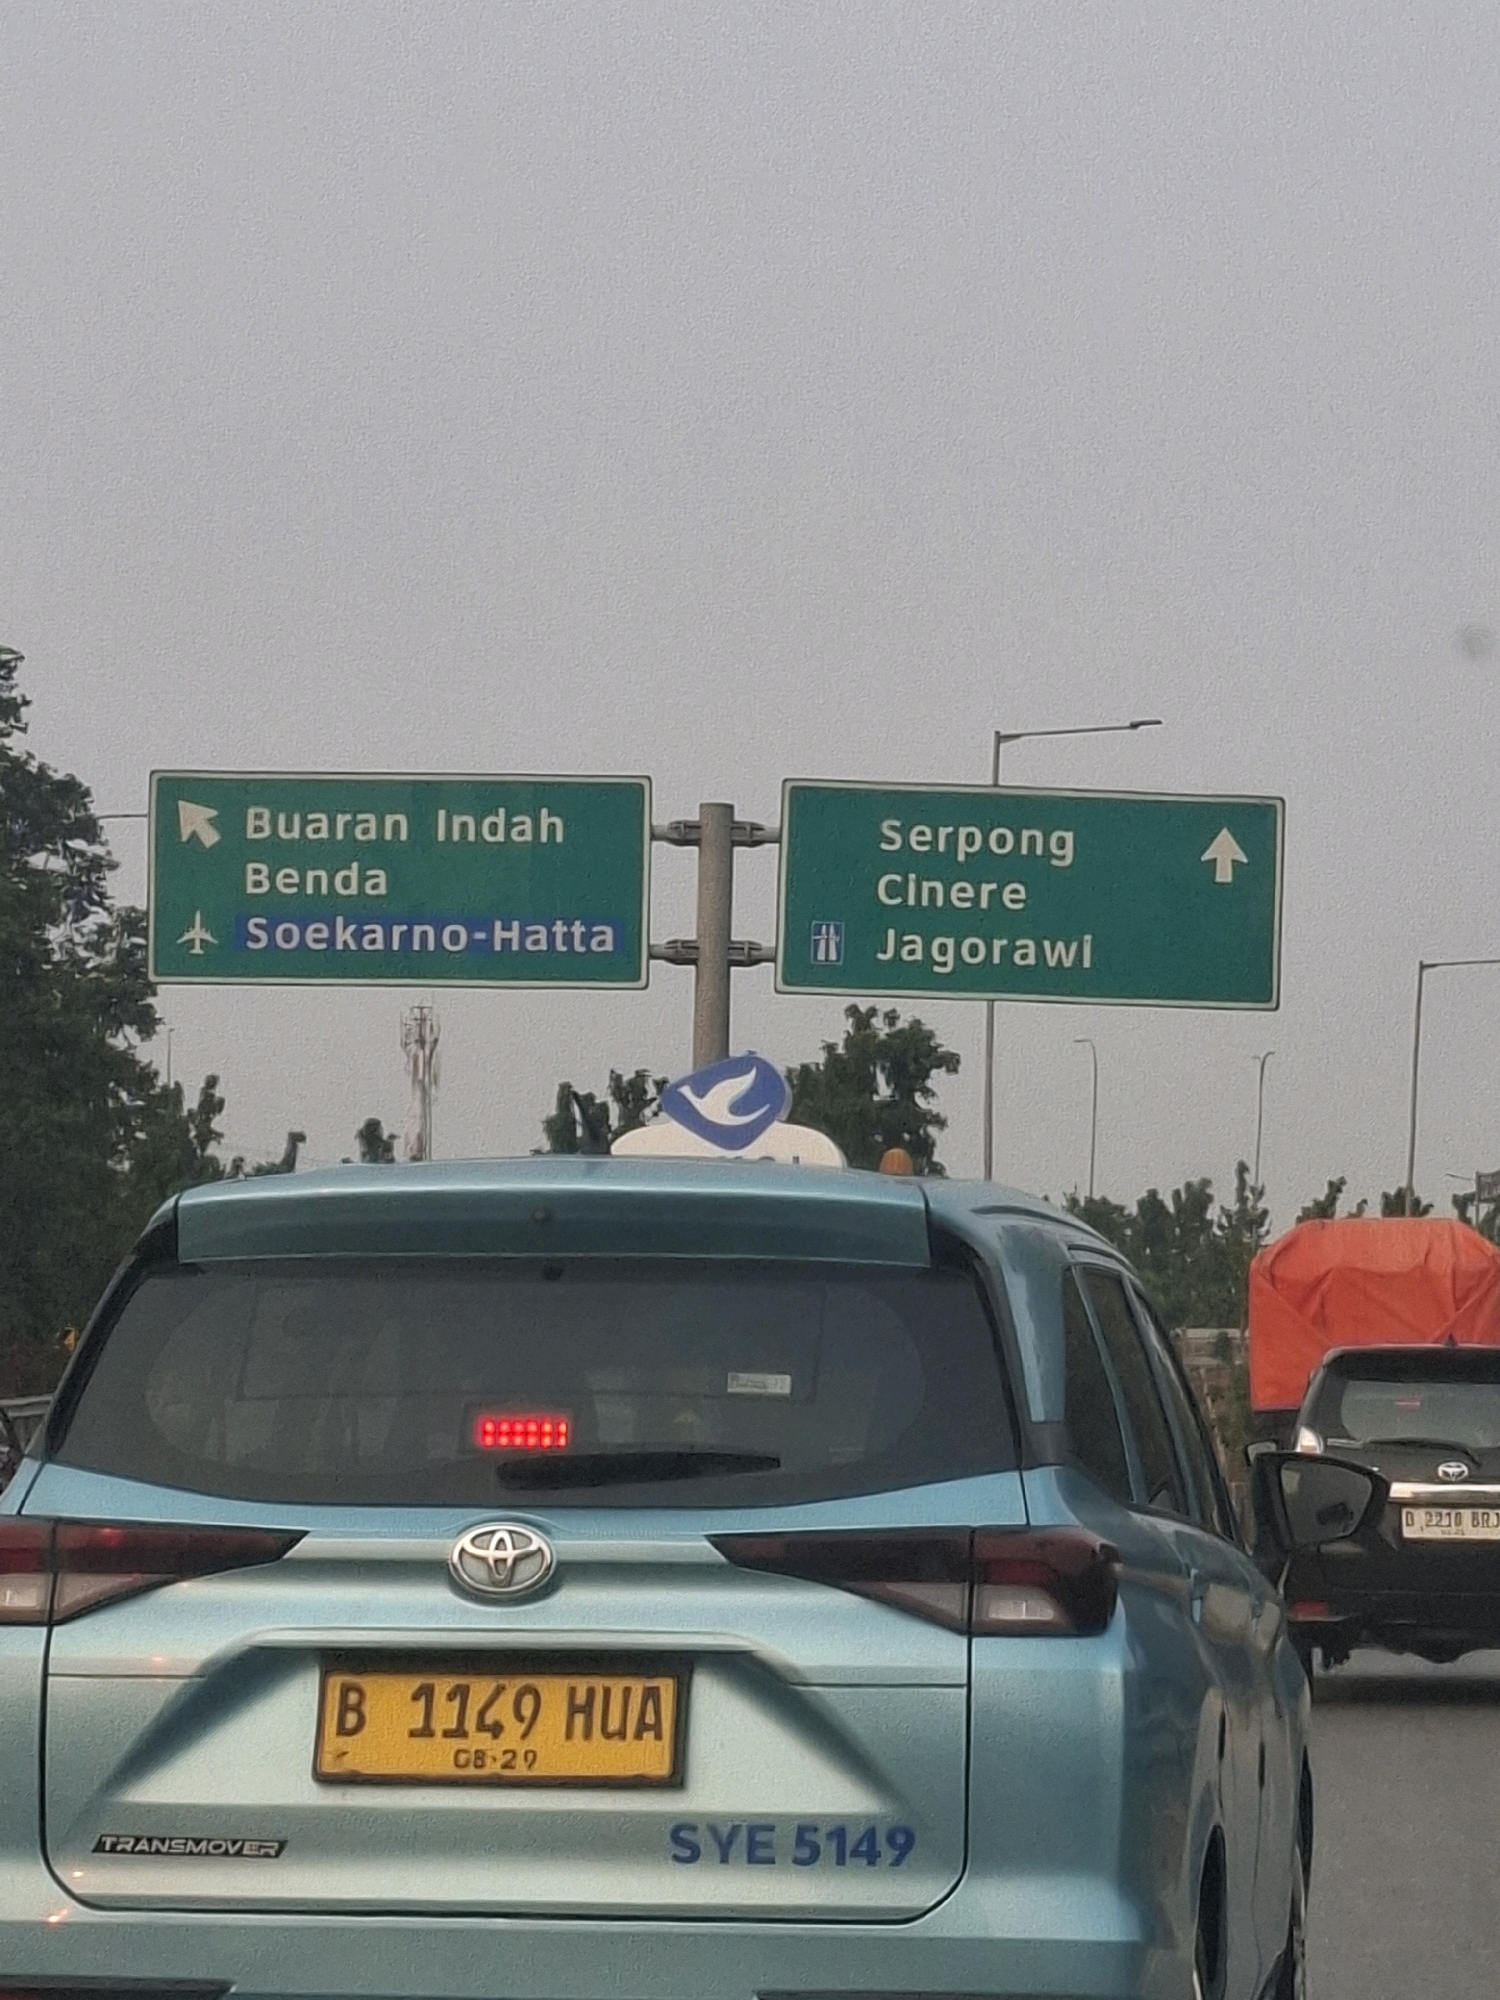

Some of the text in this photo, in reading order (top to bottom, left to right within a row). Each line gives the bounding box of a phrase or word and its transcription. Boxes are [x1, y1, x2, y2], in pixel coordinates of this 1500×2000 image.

[244, 806, 565, 844] Buaran Indah
[879, 819, 1075, 867] Serpong
[244, 862, 388, 896] Benda
[877, 873, 1028, 910] Cinere
[246, 915, 615, 954] Soekarno-Hatta
[876, 928, 1093, 973] Jagorawi
[335, 1682, 664, 1741] B 1149 HUA
[101, 1836, 279, 1857] TRANSMOVER
[669, 1823, 916, 1867] SYE 5149
